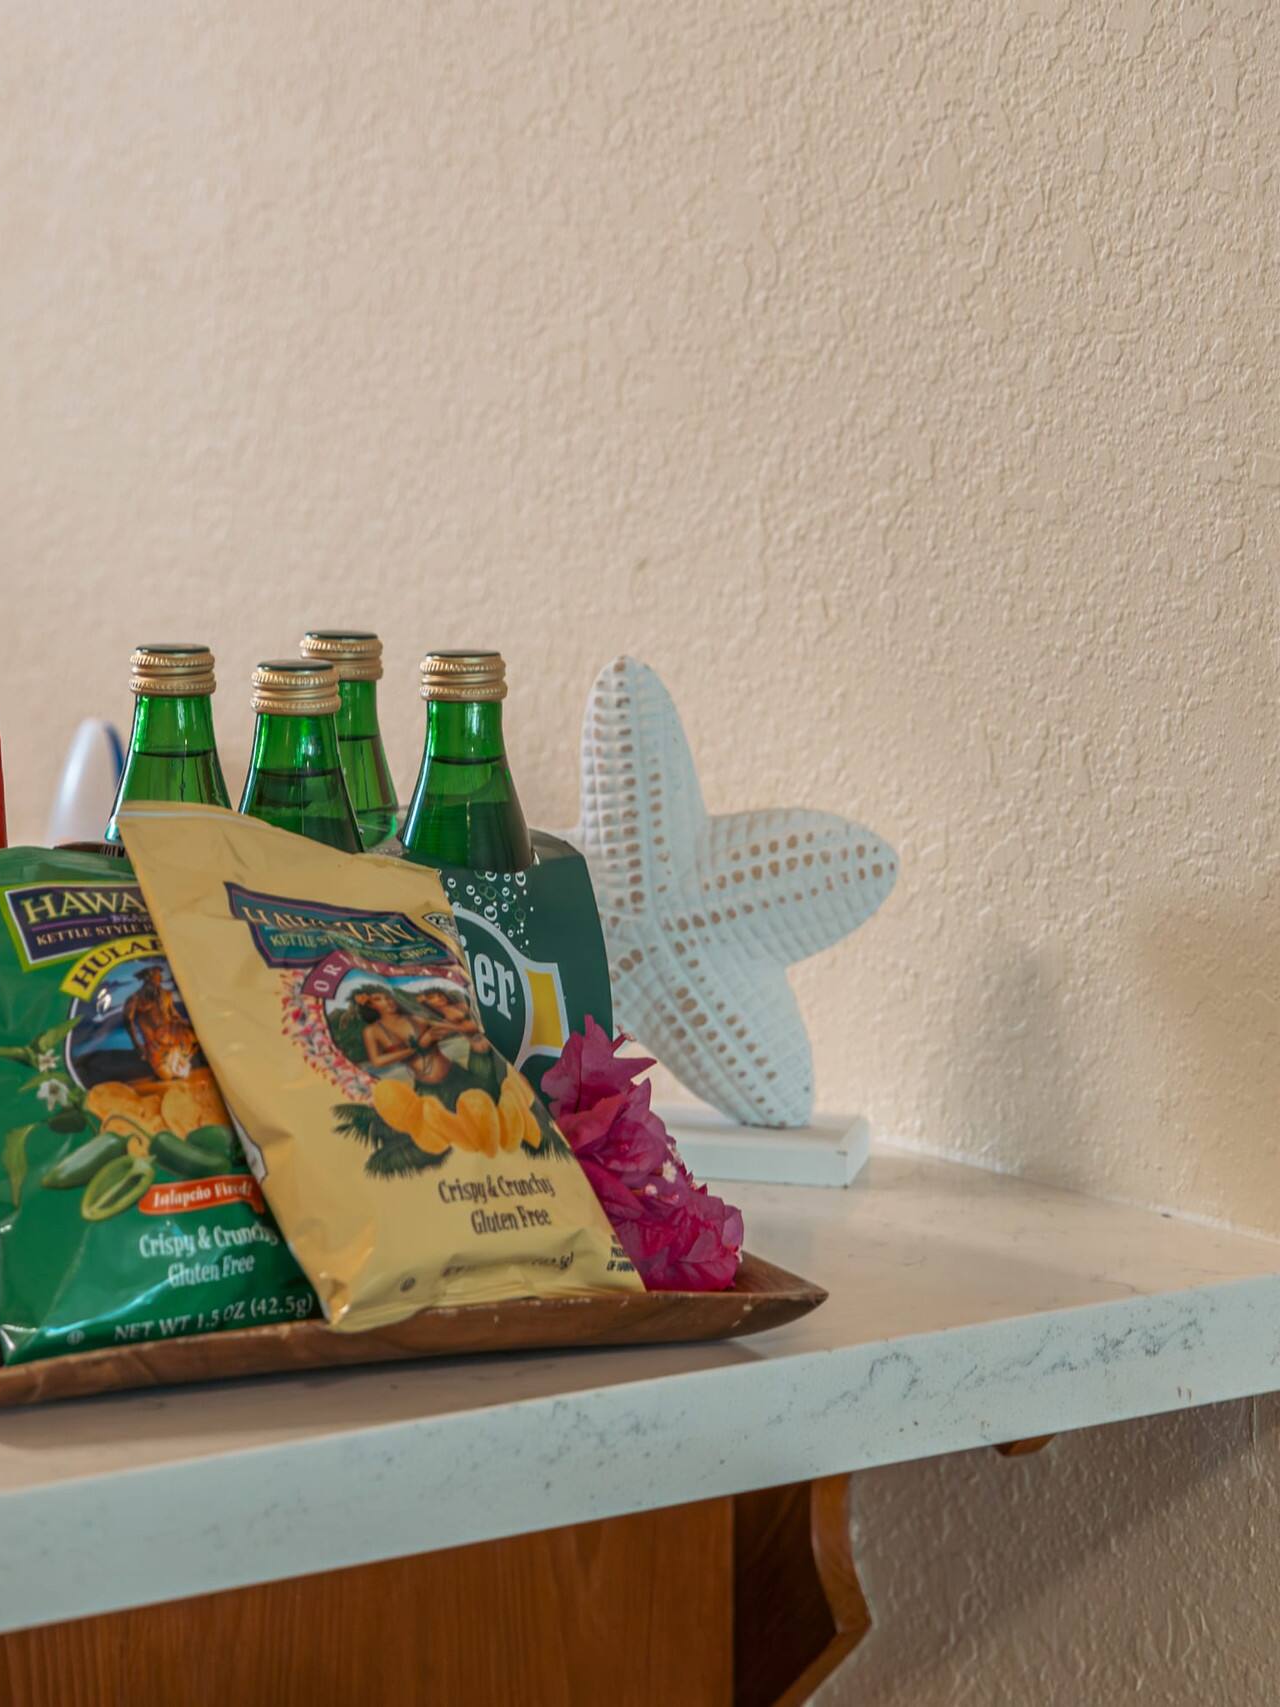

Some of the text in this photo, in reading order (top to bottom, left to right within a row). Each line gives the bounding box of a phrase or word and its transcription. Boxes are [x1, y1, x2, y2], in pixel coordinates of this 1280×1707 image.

[22, 891, 148, 923] HAWA
[36, 927, 93, 946] KETTLE
[95, 924, 139, 936] STYLE
[438, 1172, 556, 1204] Crispy & Crunchy
[470, 1205, 552, 1235] Gluten Free
[139, 1232, 196, 1258] Crispy
[197, 1225, 212, 1250] &
[168, 1254, 256, 1289] Gluten Free
[114, 1322, 154, 1341] NET
[158, 1314, 191, 1336] WT
[197, 1308, 220, 1329] 1.5
[250, 1293, 313, 1318] (42.5g)
